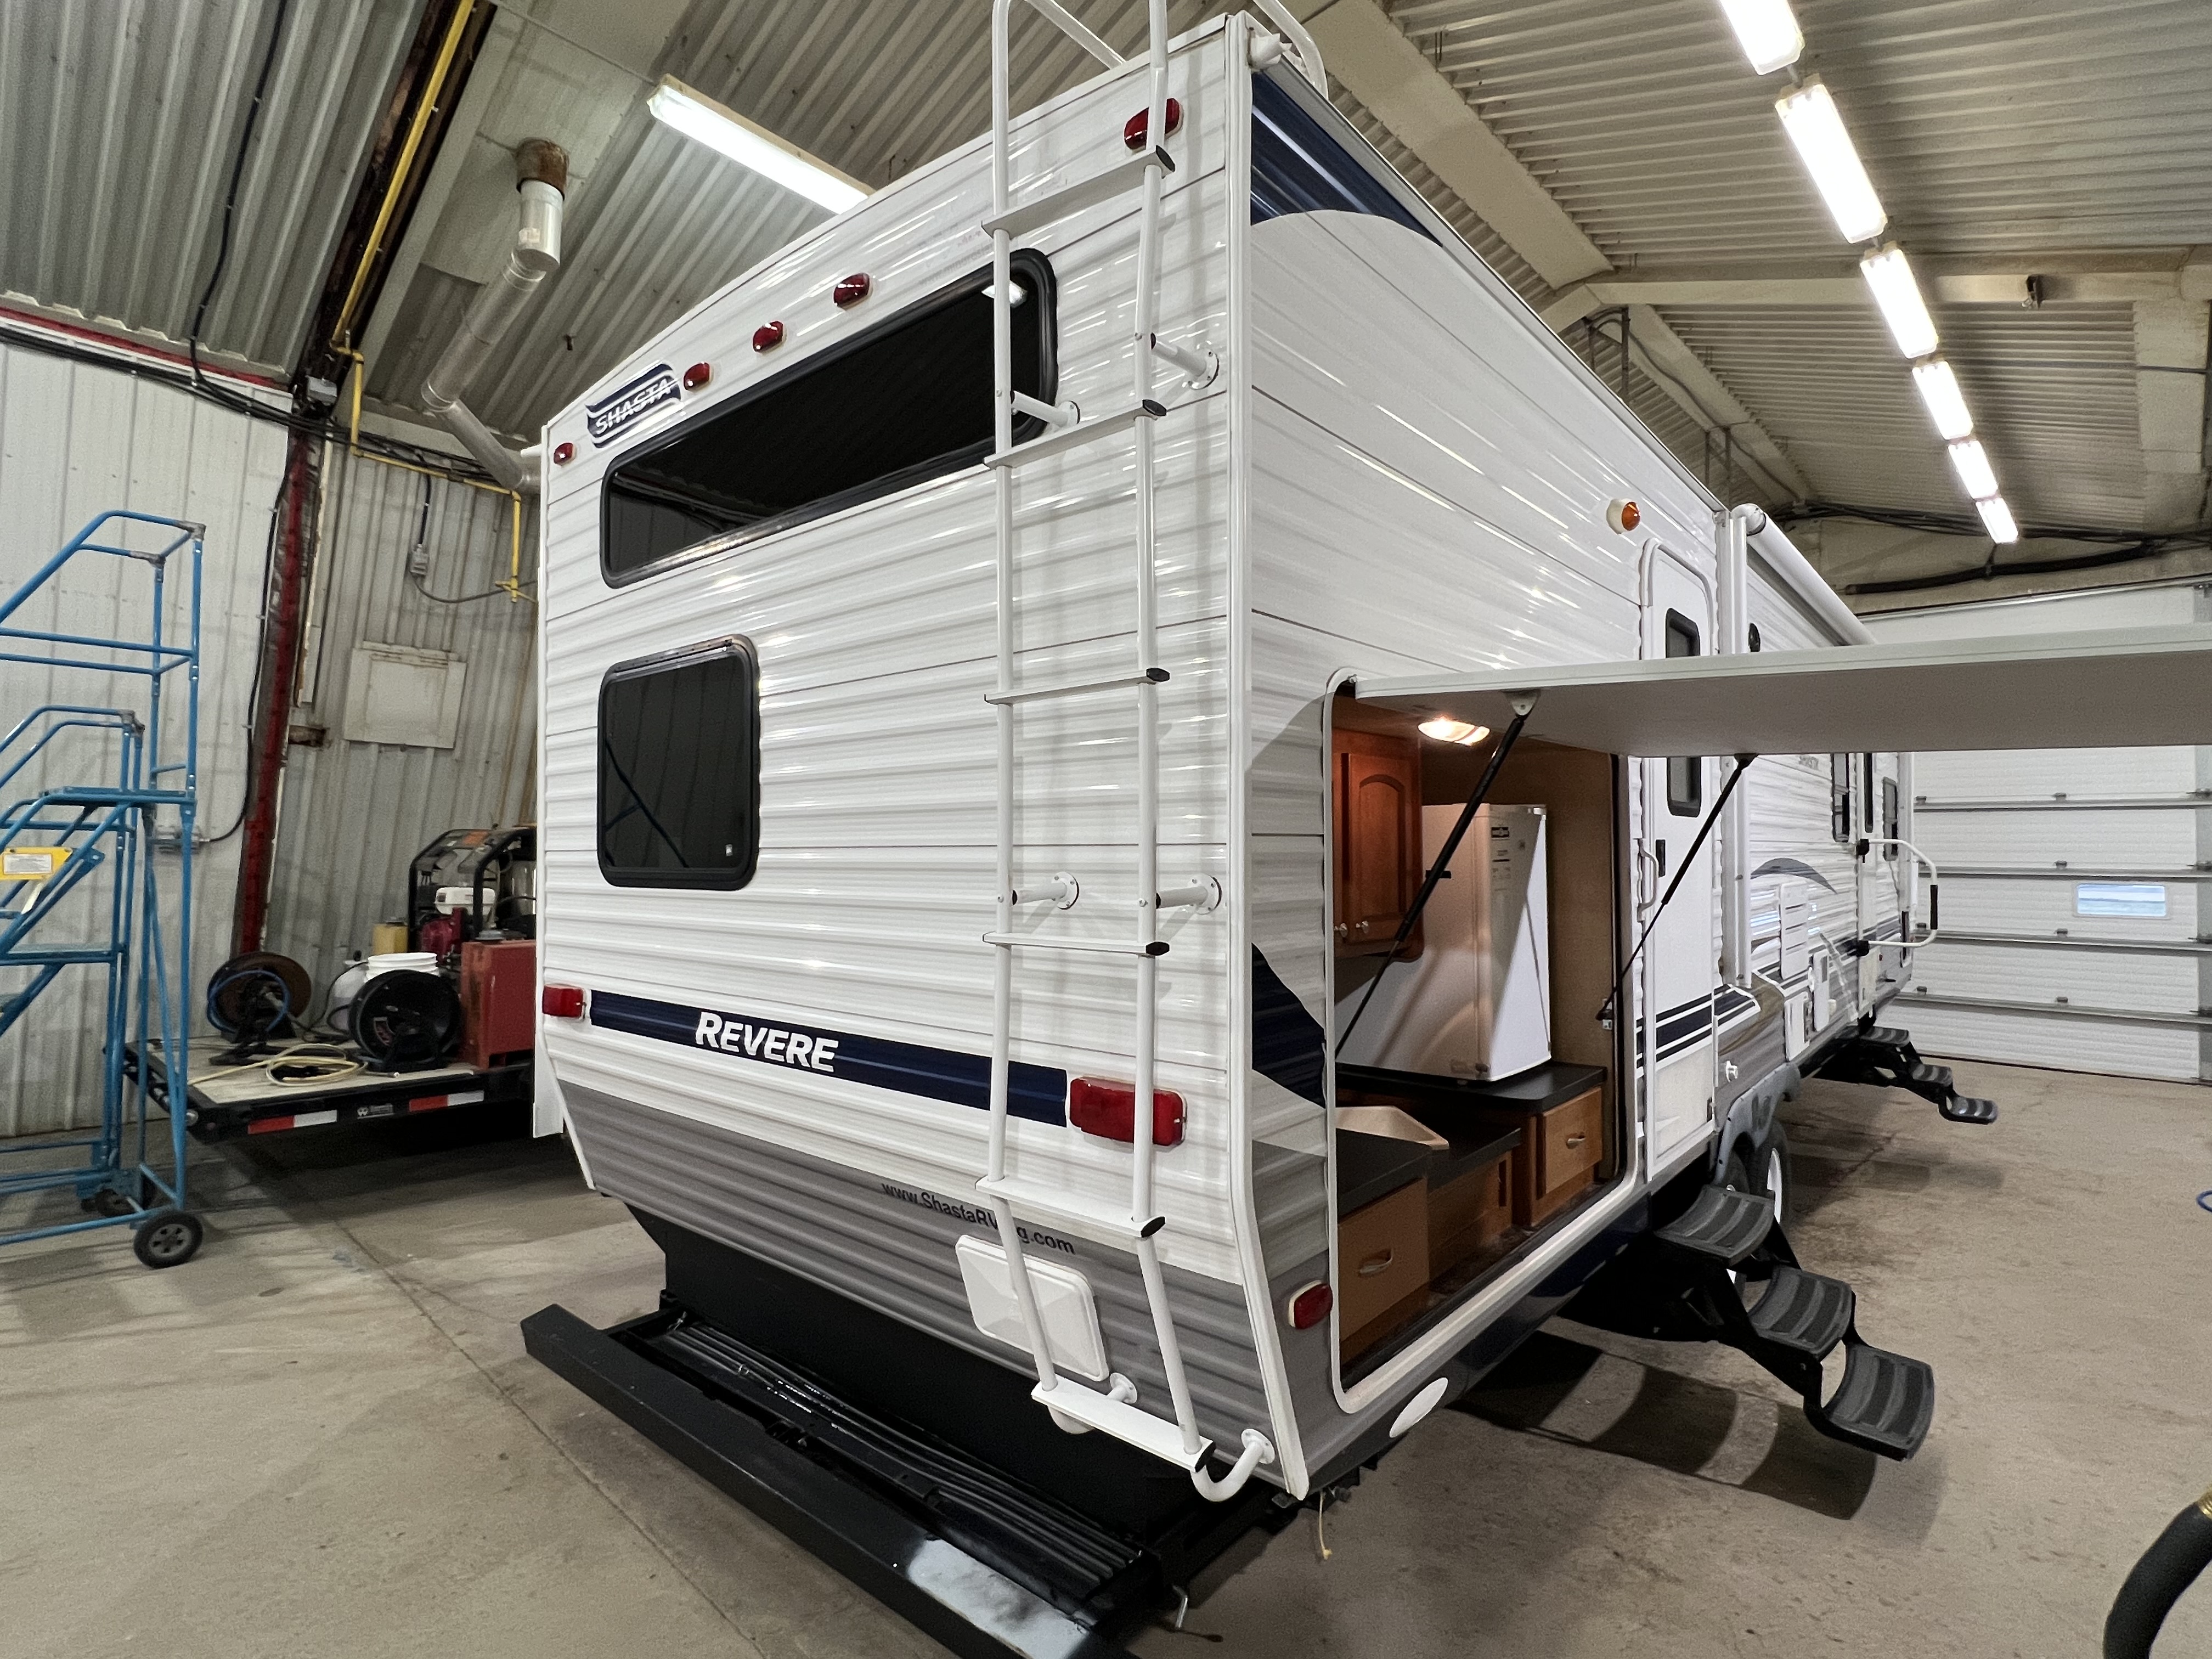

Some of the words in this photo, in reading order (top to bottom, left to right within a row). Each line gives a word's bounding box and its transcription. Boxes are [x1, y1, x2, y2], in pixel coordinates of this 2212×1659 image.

[595, 378, 672, 435] SHASTA
[695, 1011, 839, 1073] REVERE
[881, 1183, 1075, 1255] www.ShastaRVg.com
